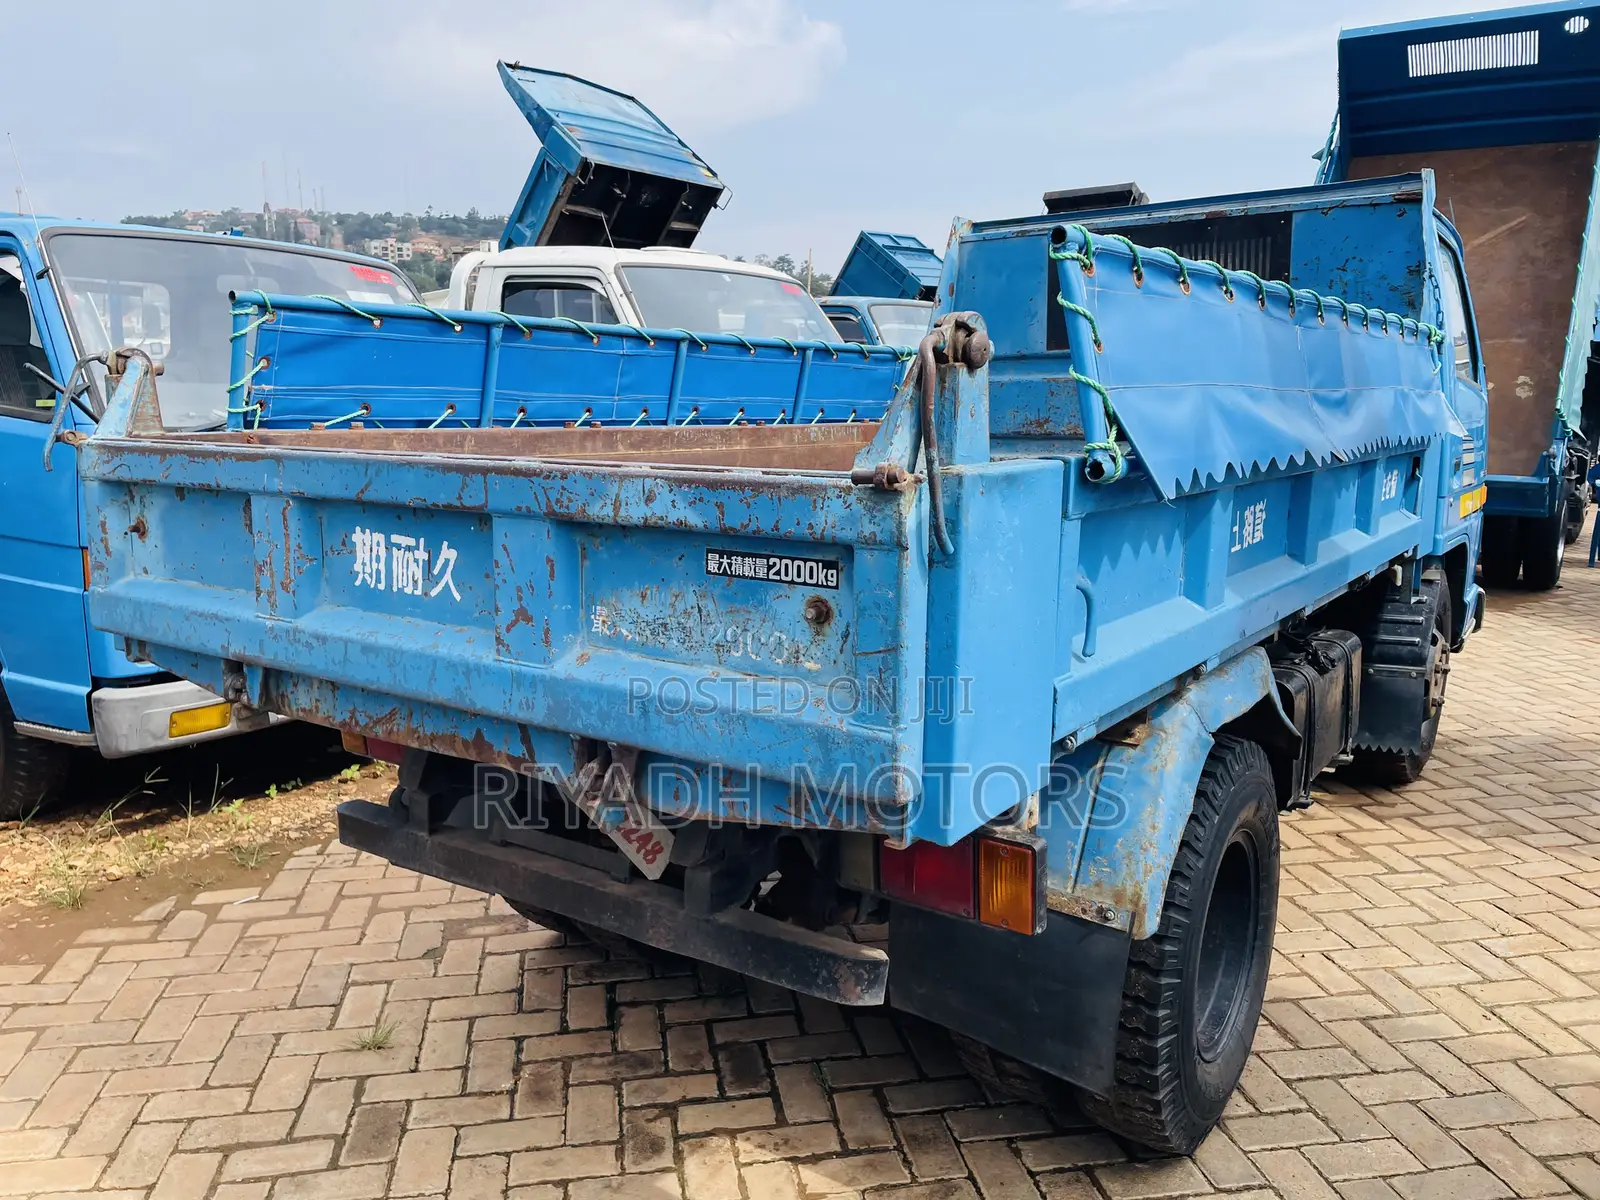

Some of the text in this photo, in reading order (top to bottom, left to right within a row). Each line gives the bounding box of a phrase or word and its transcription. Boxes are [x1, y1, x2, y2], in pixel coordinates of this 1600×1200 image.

[707, 552, 838, 588] 最大積載量2000kg
